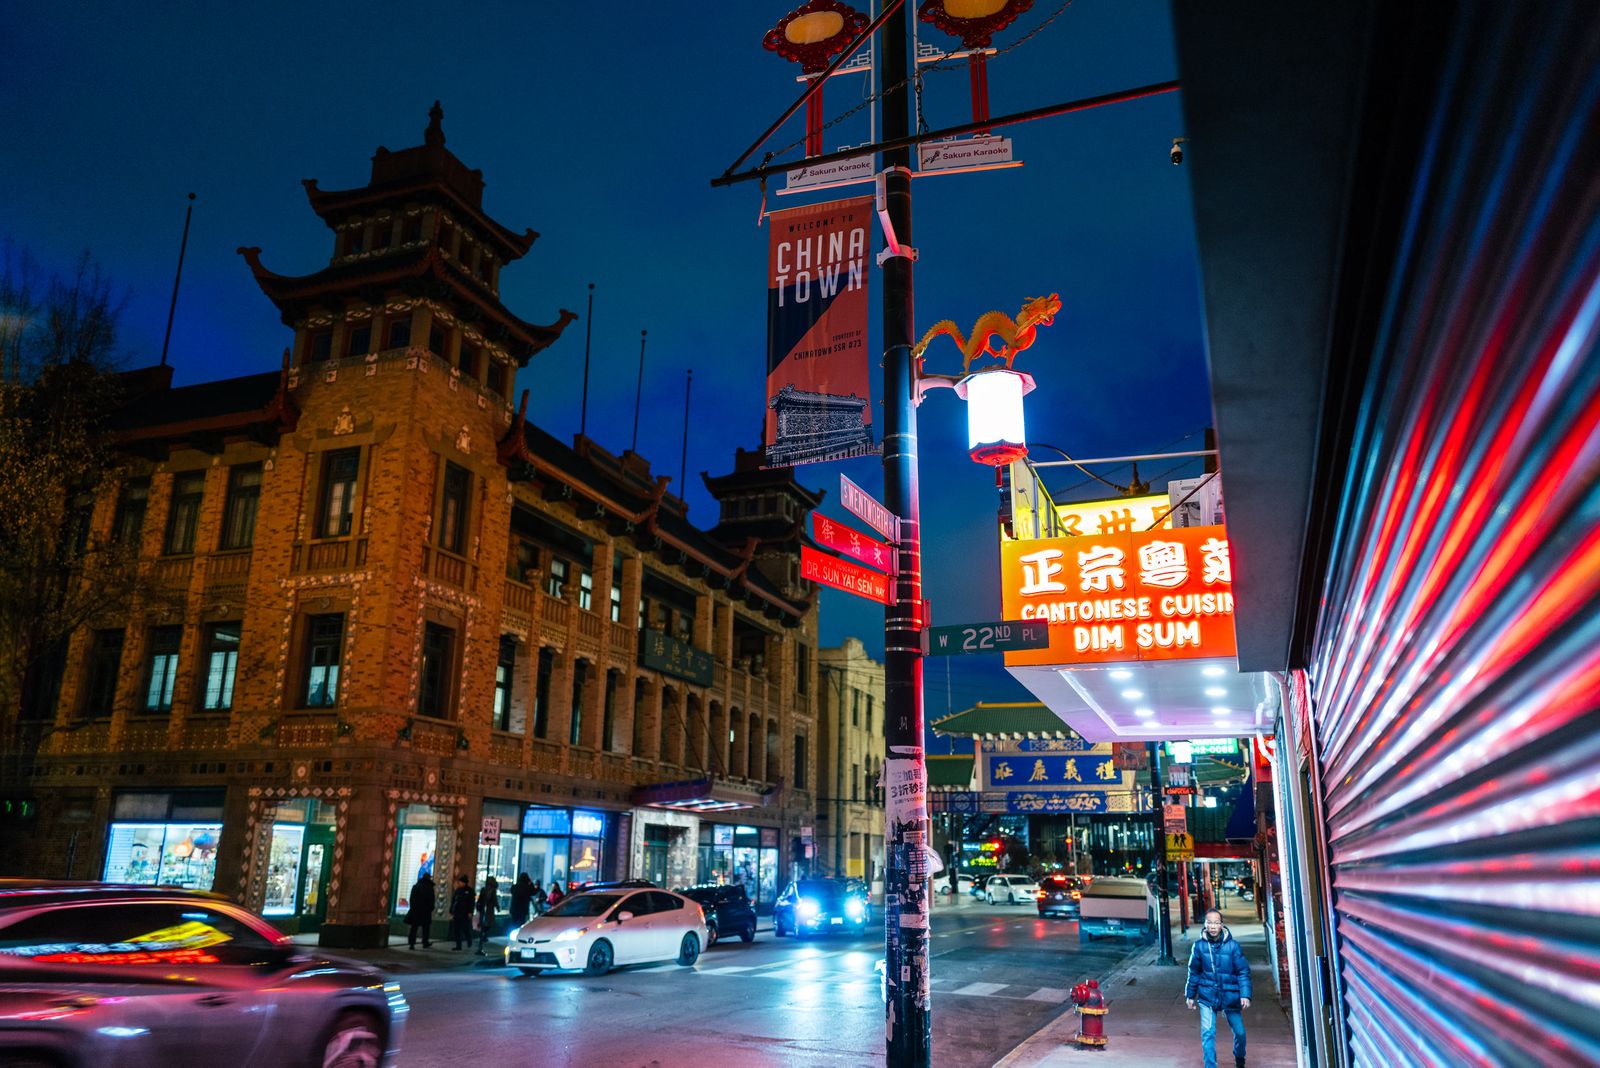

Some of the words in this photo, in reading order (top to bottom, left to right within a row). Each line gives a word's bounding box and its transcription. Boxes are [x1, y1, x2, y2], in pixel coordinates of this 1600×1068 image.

[942, 149, 972, 160] Sakura
[974, 146, 1008, 157] Karaoke
[809, 164, 837, 176] Sakura
[789, 218, 835, 232] WELCOME
[842, 214, 853, 223] TO
[777, 227, 865, 274] CHINA
[775, 258, 863, 307] TOWN
[794, 346, 832, 361] CHINATOWN
[843, 485, 848, 499] S
[848, 484, 889, 534] WENTWORTH
[806, 560, 820, 578] DR.
[823, 566, 840, 585] SUN
[842, 571, 856, 589] YAT
[857, 577, 873, 595] SEN
[875, 585, 885, 597] WAY
[1021, 597, 1152, 623] CANTONESE
[939, 634, 948, 648] W
[962, 625, 1011, 650] 22ND
[1022, 628, 1037, 641] PL
[1073, 625, 1124, 652] DIM
[1136, 620, 1200, 648] SUM
[484, 820, 498, 828] ONE
